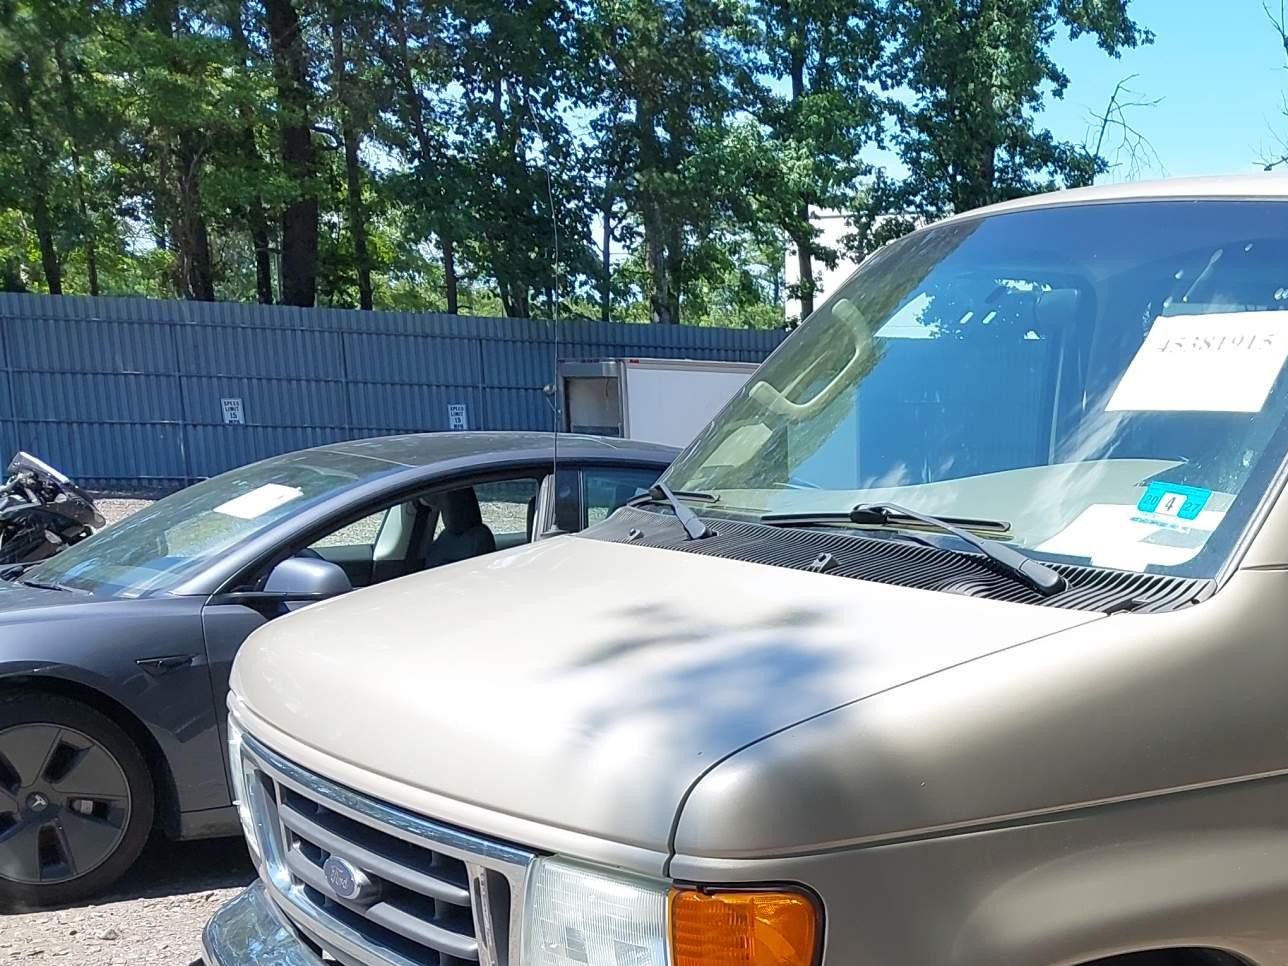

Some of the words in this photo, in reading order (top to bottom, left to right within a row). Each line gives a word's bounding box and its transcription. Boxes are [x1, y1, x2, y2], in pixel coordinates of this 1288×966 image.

[1144, 495, 1159, 506] 20
[1164, 496, 1177, 511] 4
[1184, 503, 1201, 511] 27
